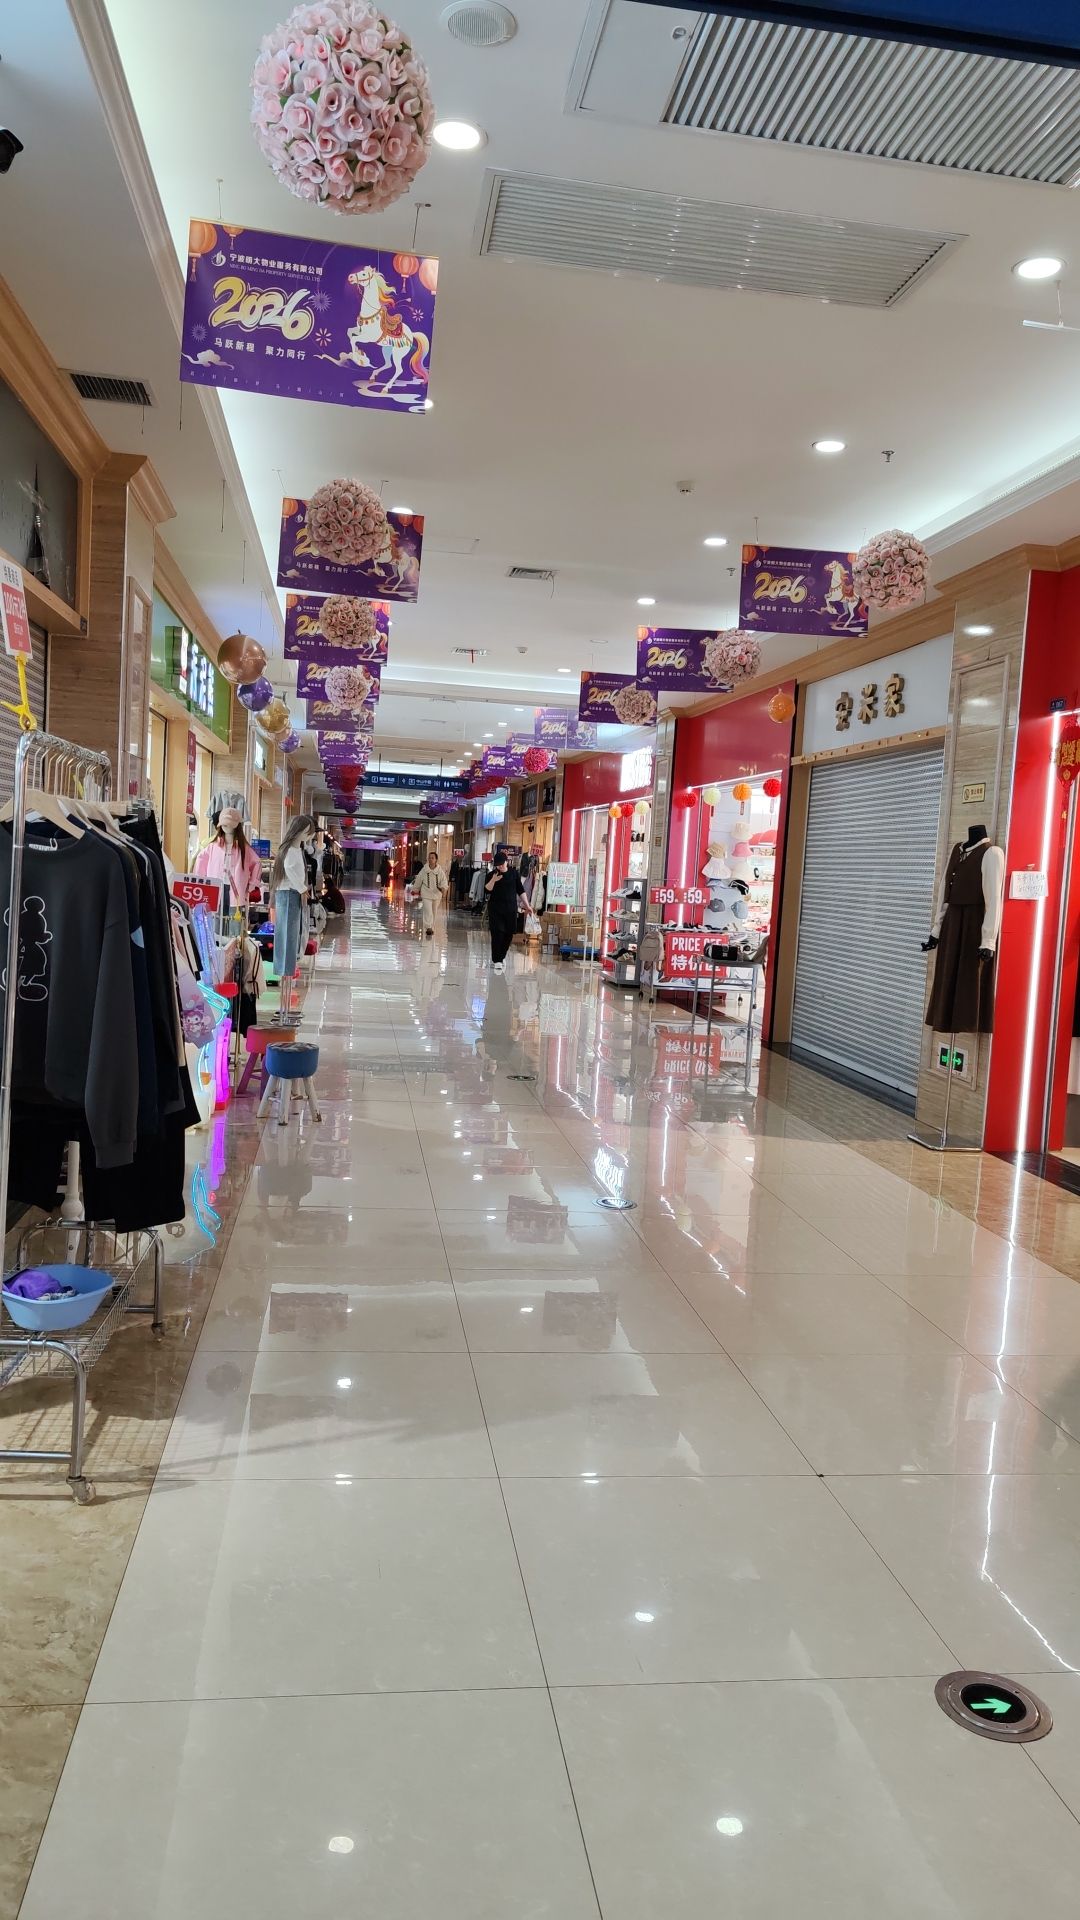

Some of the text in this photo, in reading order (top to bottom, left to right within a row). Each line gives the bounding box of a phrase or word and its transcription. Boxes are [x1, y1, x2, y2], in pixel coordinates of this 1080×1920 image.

[230, 253, 323, 276] 宁波明大物业服务有限公司
[209, 276, 315, 341] 2026
[214, 337, 306, 361] 马跃新程 聚力同行
[753, 572, 808, 604] 2026
[646, 646, 688, 670] 2026
[541, 720, 567, 736] 2026
[672, 937, 700, 952] PRICE
